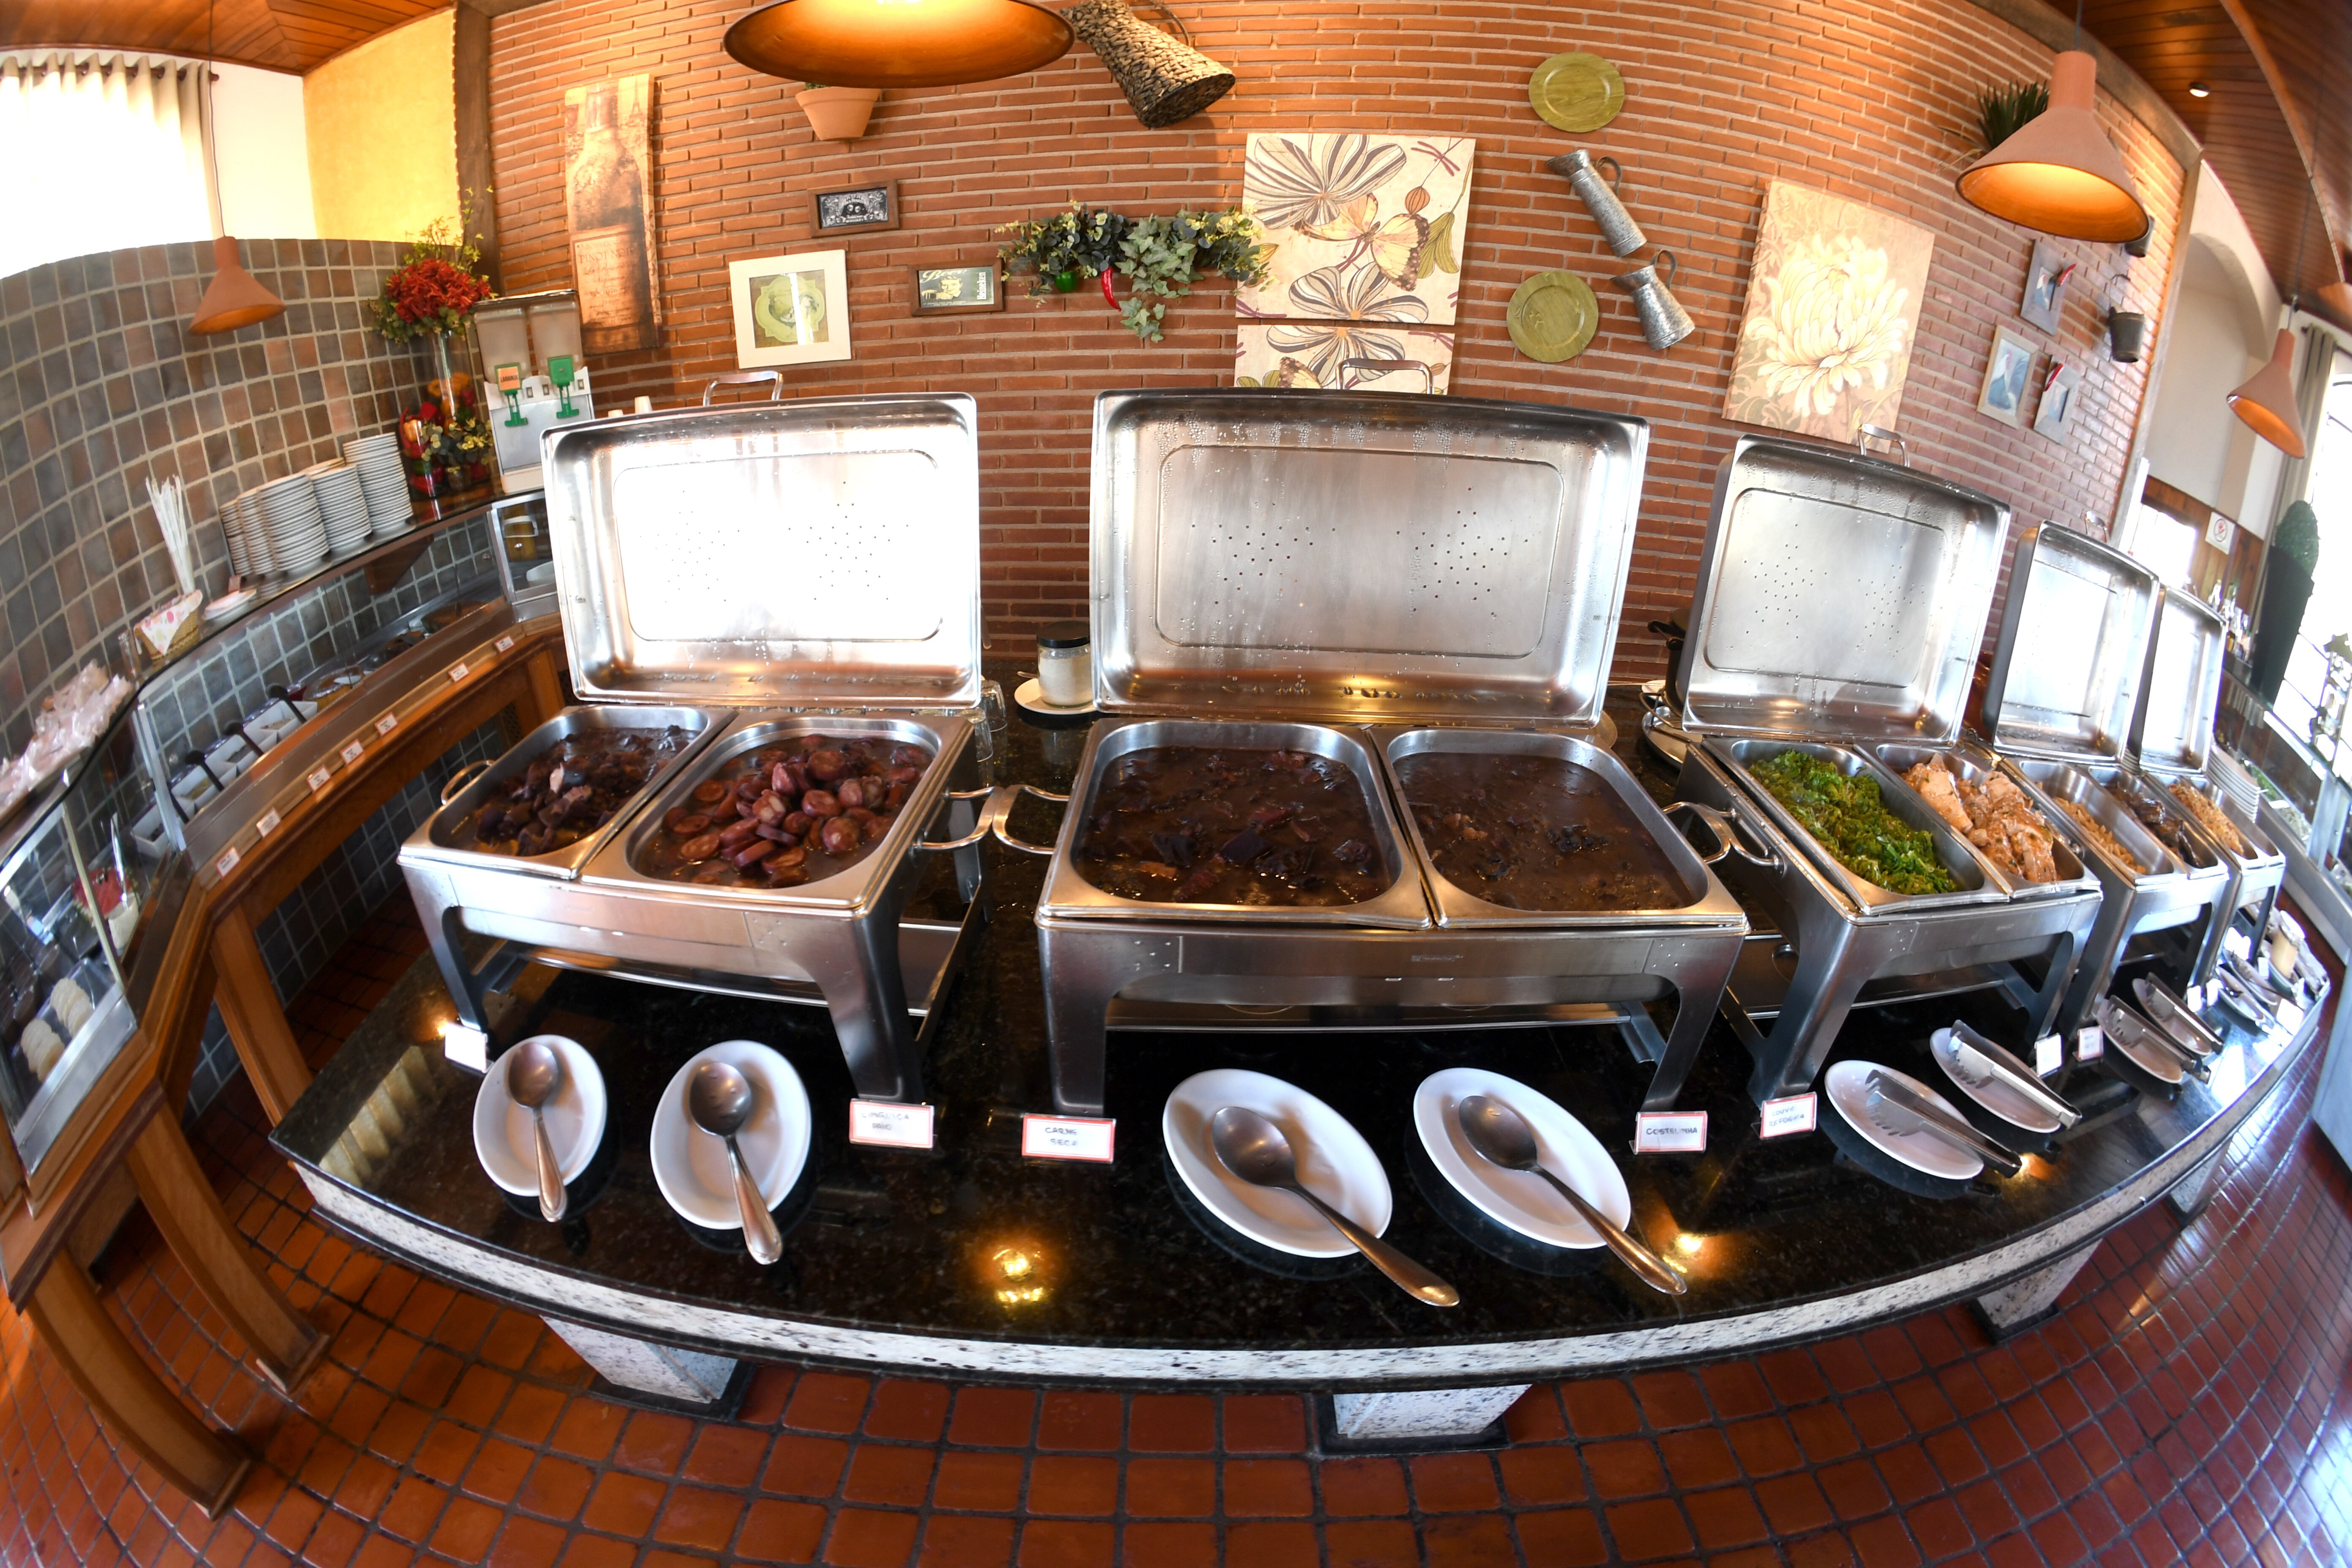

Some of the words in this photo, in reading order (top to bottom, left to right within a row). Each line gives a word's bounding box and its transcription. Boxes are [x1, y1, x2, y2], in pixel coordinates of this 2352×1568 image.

[578, 251, 609, 264] PINOT
[977, 272, 987, 300] Heineken
[1646, 1127, 1698, 1135] COSTELNHA
